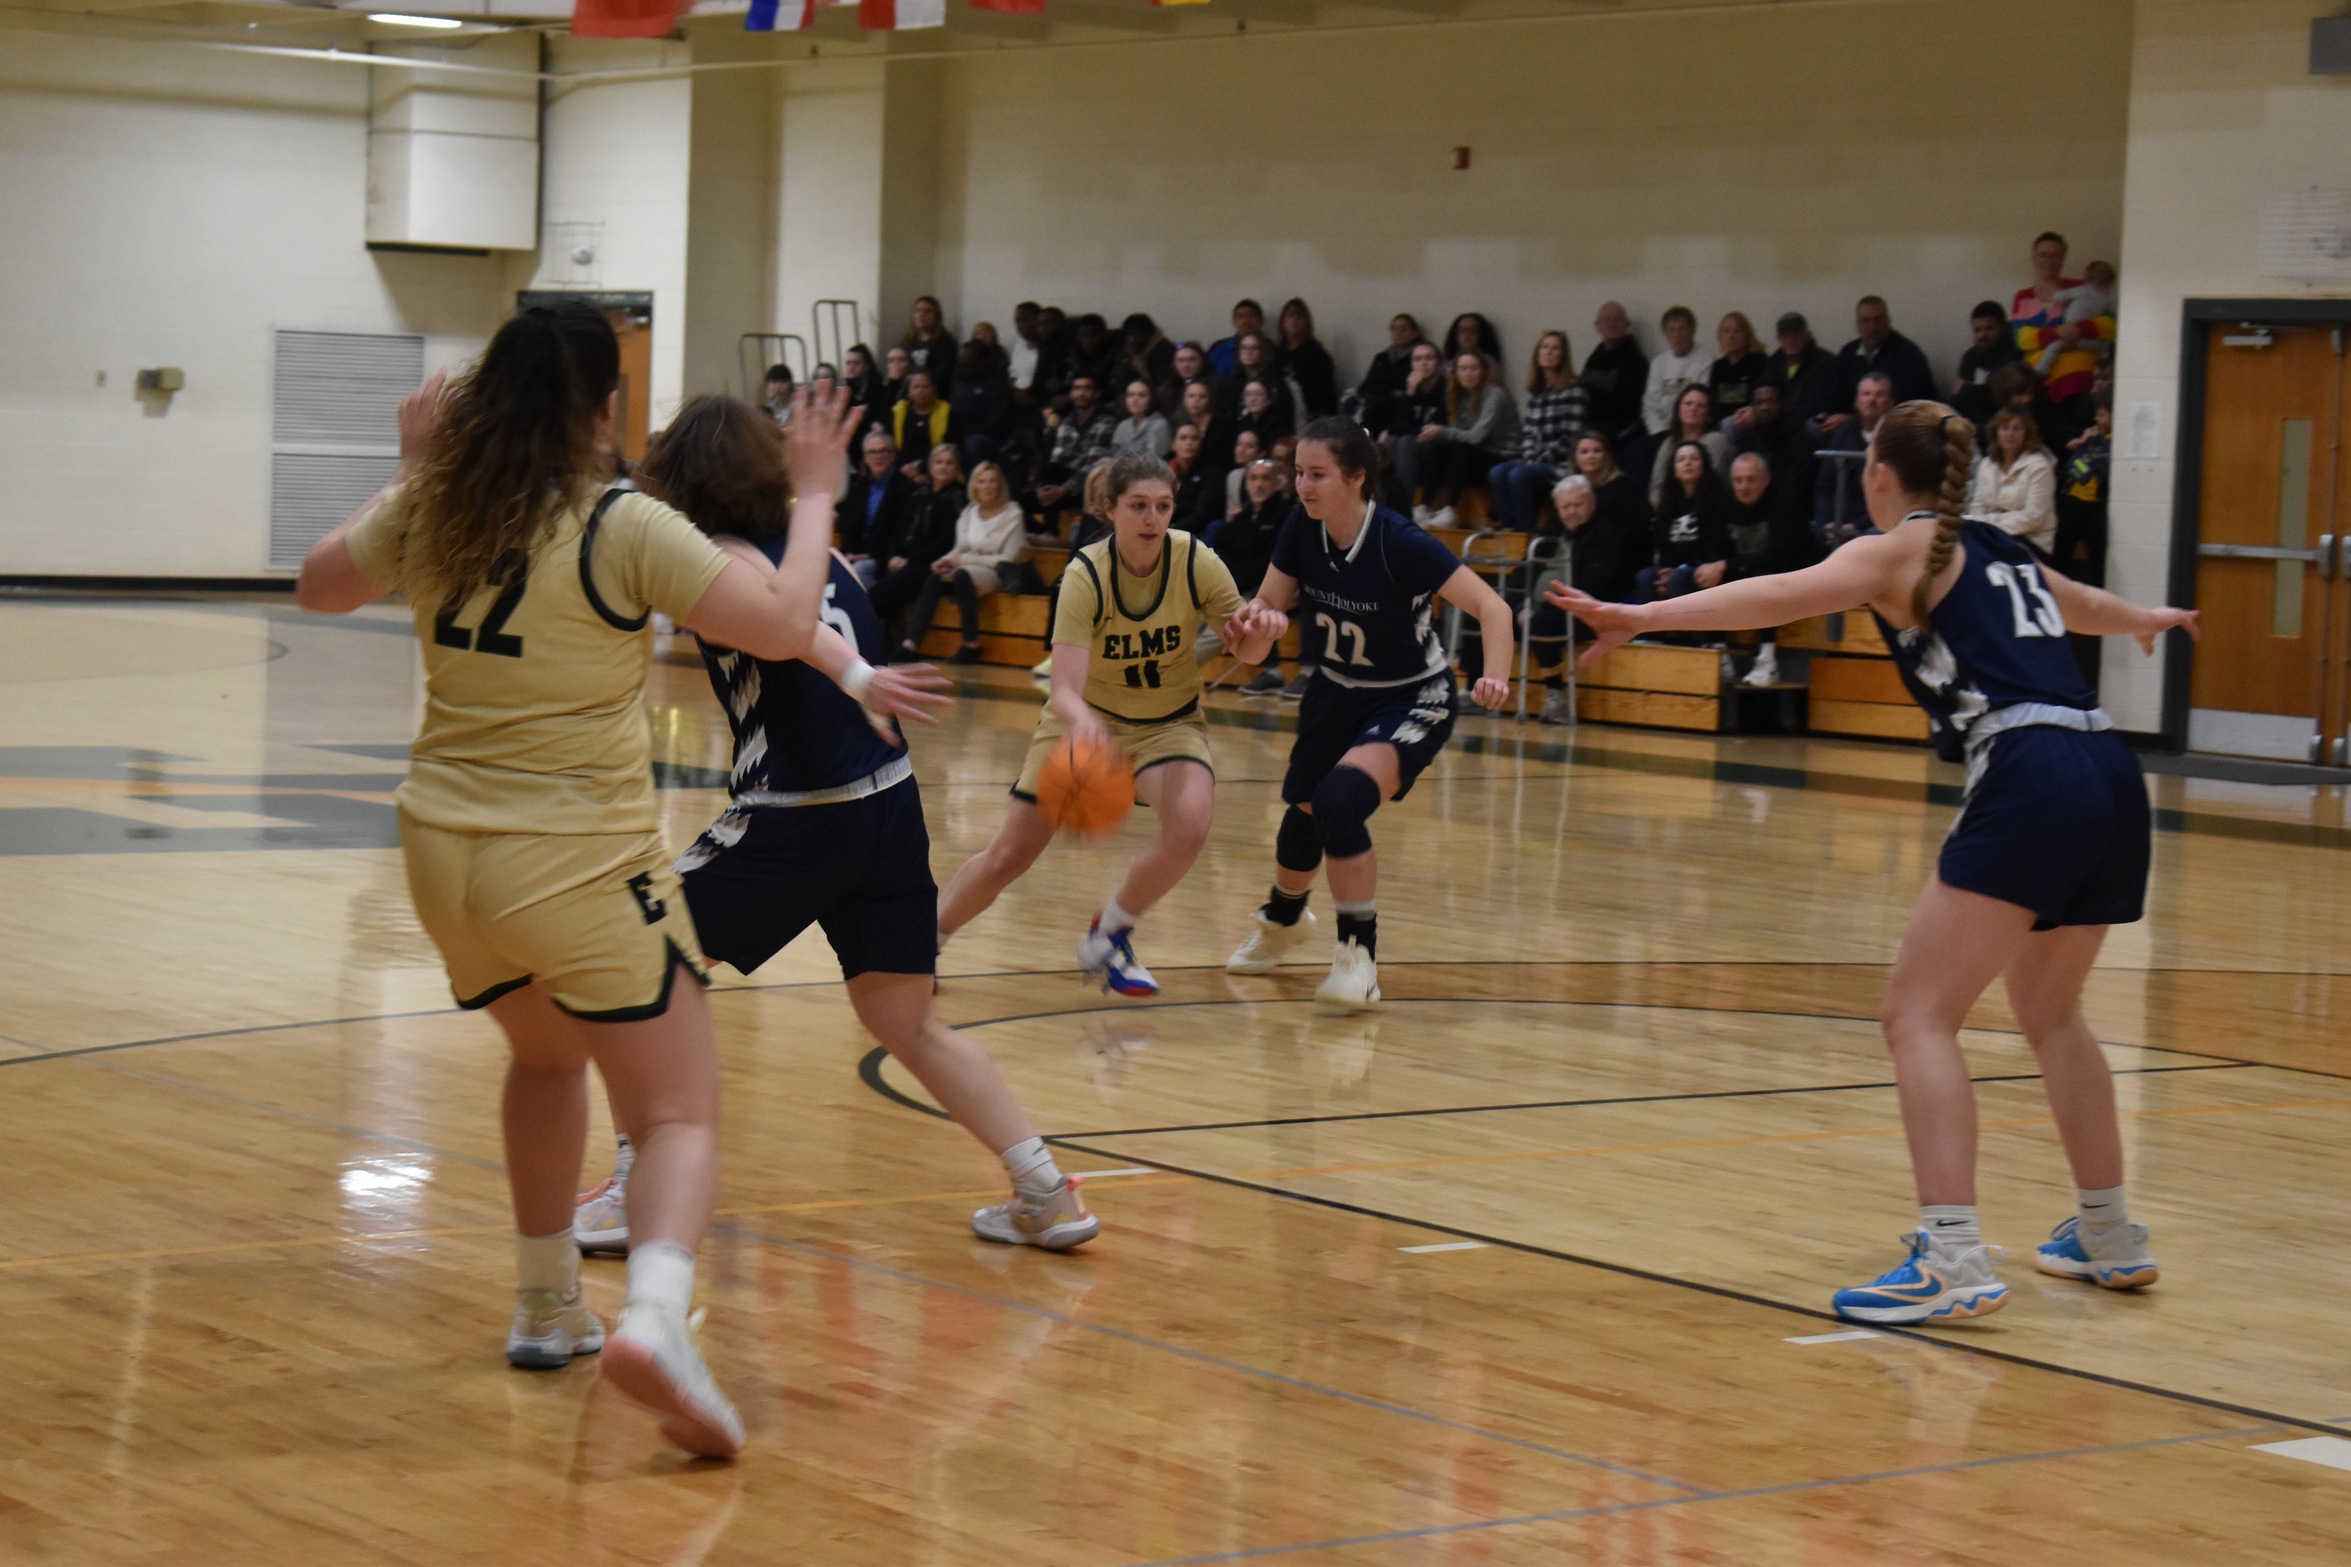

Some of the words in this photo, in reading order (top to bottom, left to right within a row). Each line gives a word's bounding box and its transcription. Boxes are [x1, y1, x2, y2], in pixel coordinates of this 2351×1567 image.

[1986, 561, 2066, 638] 23
[1102, 625, 1181, 659] ELMS
[1315, 612, 1375, 667] 22
[626, 872, 668, 926] E
